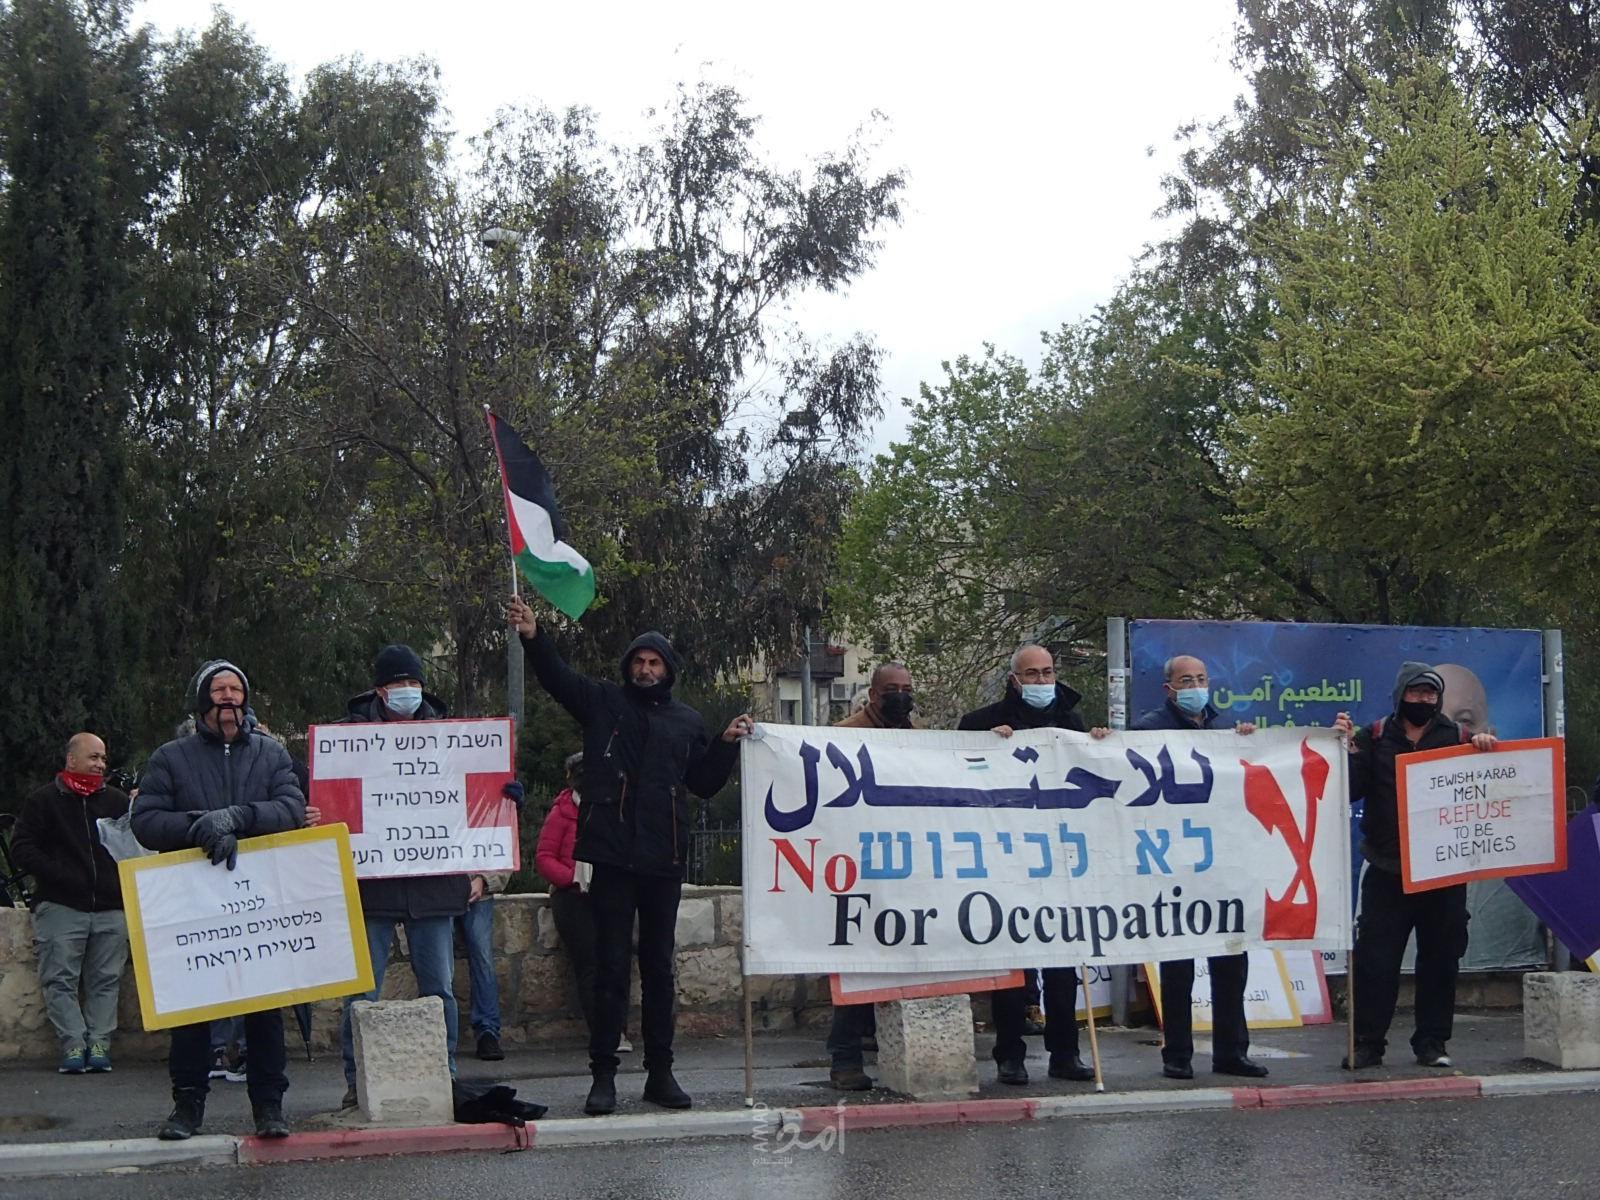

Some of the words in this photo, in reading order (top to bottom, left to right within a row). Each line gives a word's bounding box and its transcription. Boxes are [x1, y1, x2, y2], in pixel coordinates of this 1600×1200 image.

[1279, 679, 1362, 711] التطعيم
[319, 733, 385, 754] ליהודים
[395, 735, 438, 750] רכוש
[447, 733, 503, 749] השבת
[392, 757, 440, 776] בלבד
[1429, 771, 1474, 790] JEWISH
[1484, 767, 1517, 783] ARAB
[371, 789, 460, 807] אפרטהייד
[1453, 784, 1487, 803] MEN
[1438, 800, 1512, 826] REFUSE
[386, 825, 450, 841] בברכת
[1453, 826, 1470, 840] TO
[1474, 823, 1494, 837] BE
[394, 845, 463, 861] המשפט
[473, 843, 506, 857] בית
[859, 822, 1088, 880] לכיבוש
[1136, 818, 1214, 875] לא
[1436, 835, 1517, 862] ENEMIES
[767, 838, 858, 893] No
[234, 879, 250, 891] די
[221, 895, 266, 915] לפינוי
[247, 910, 323, 934] פלסטינים
[828, 893, 938, 946] For
[957, 885, 1246, 957] Occupation
[176, 925, 242, 946] מבתיהם
[257, 936, 316, 959] בשייח
